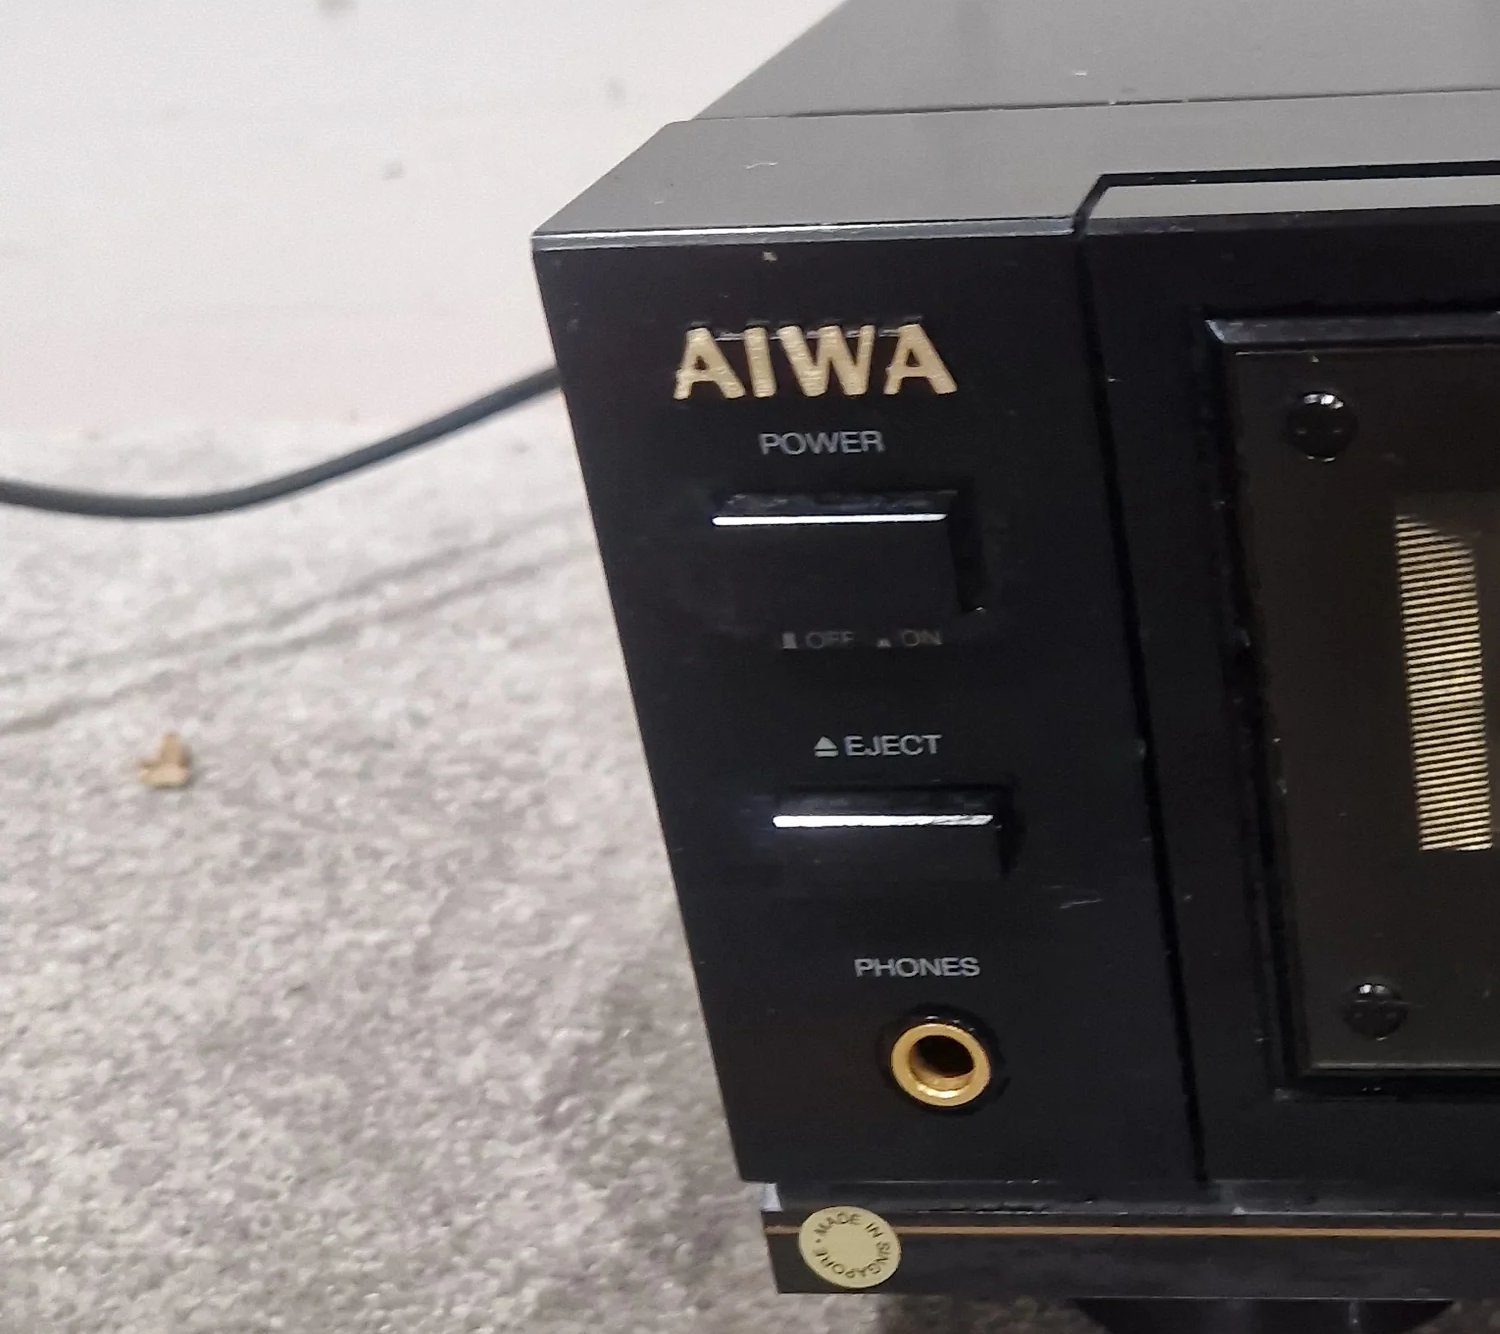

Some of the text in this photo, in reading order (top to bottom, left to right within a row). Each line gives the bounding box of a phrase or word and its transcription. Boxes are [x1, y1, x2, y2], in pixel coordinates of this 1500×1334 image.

[673, 323, 958, 401] AIWA
[758, 430, 885, 456] POWER
[843, 734, 943, 757] EJECT
[854, 956, 981, 978] PHONES
[865, 1221, 883, 1238] IN
